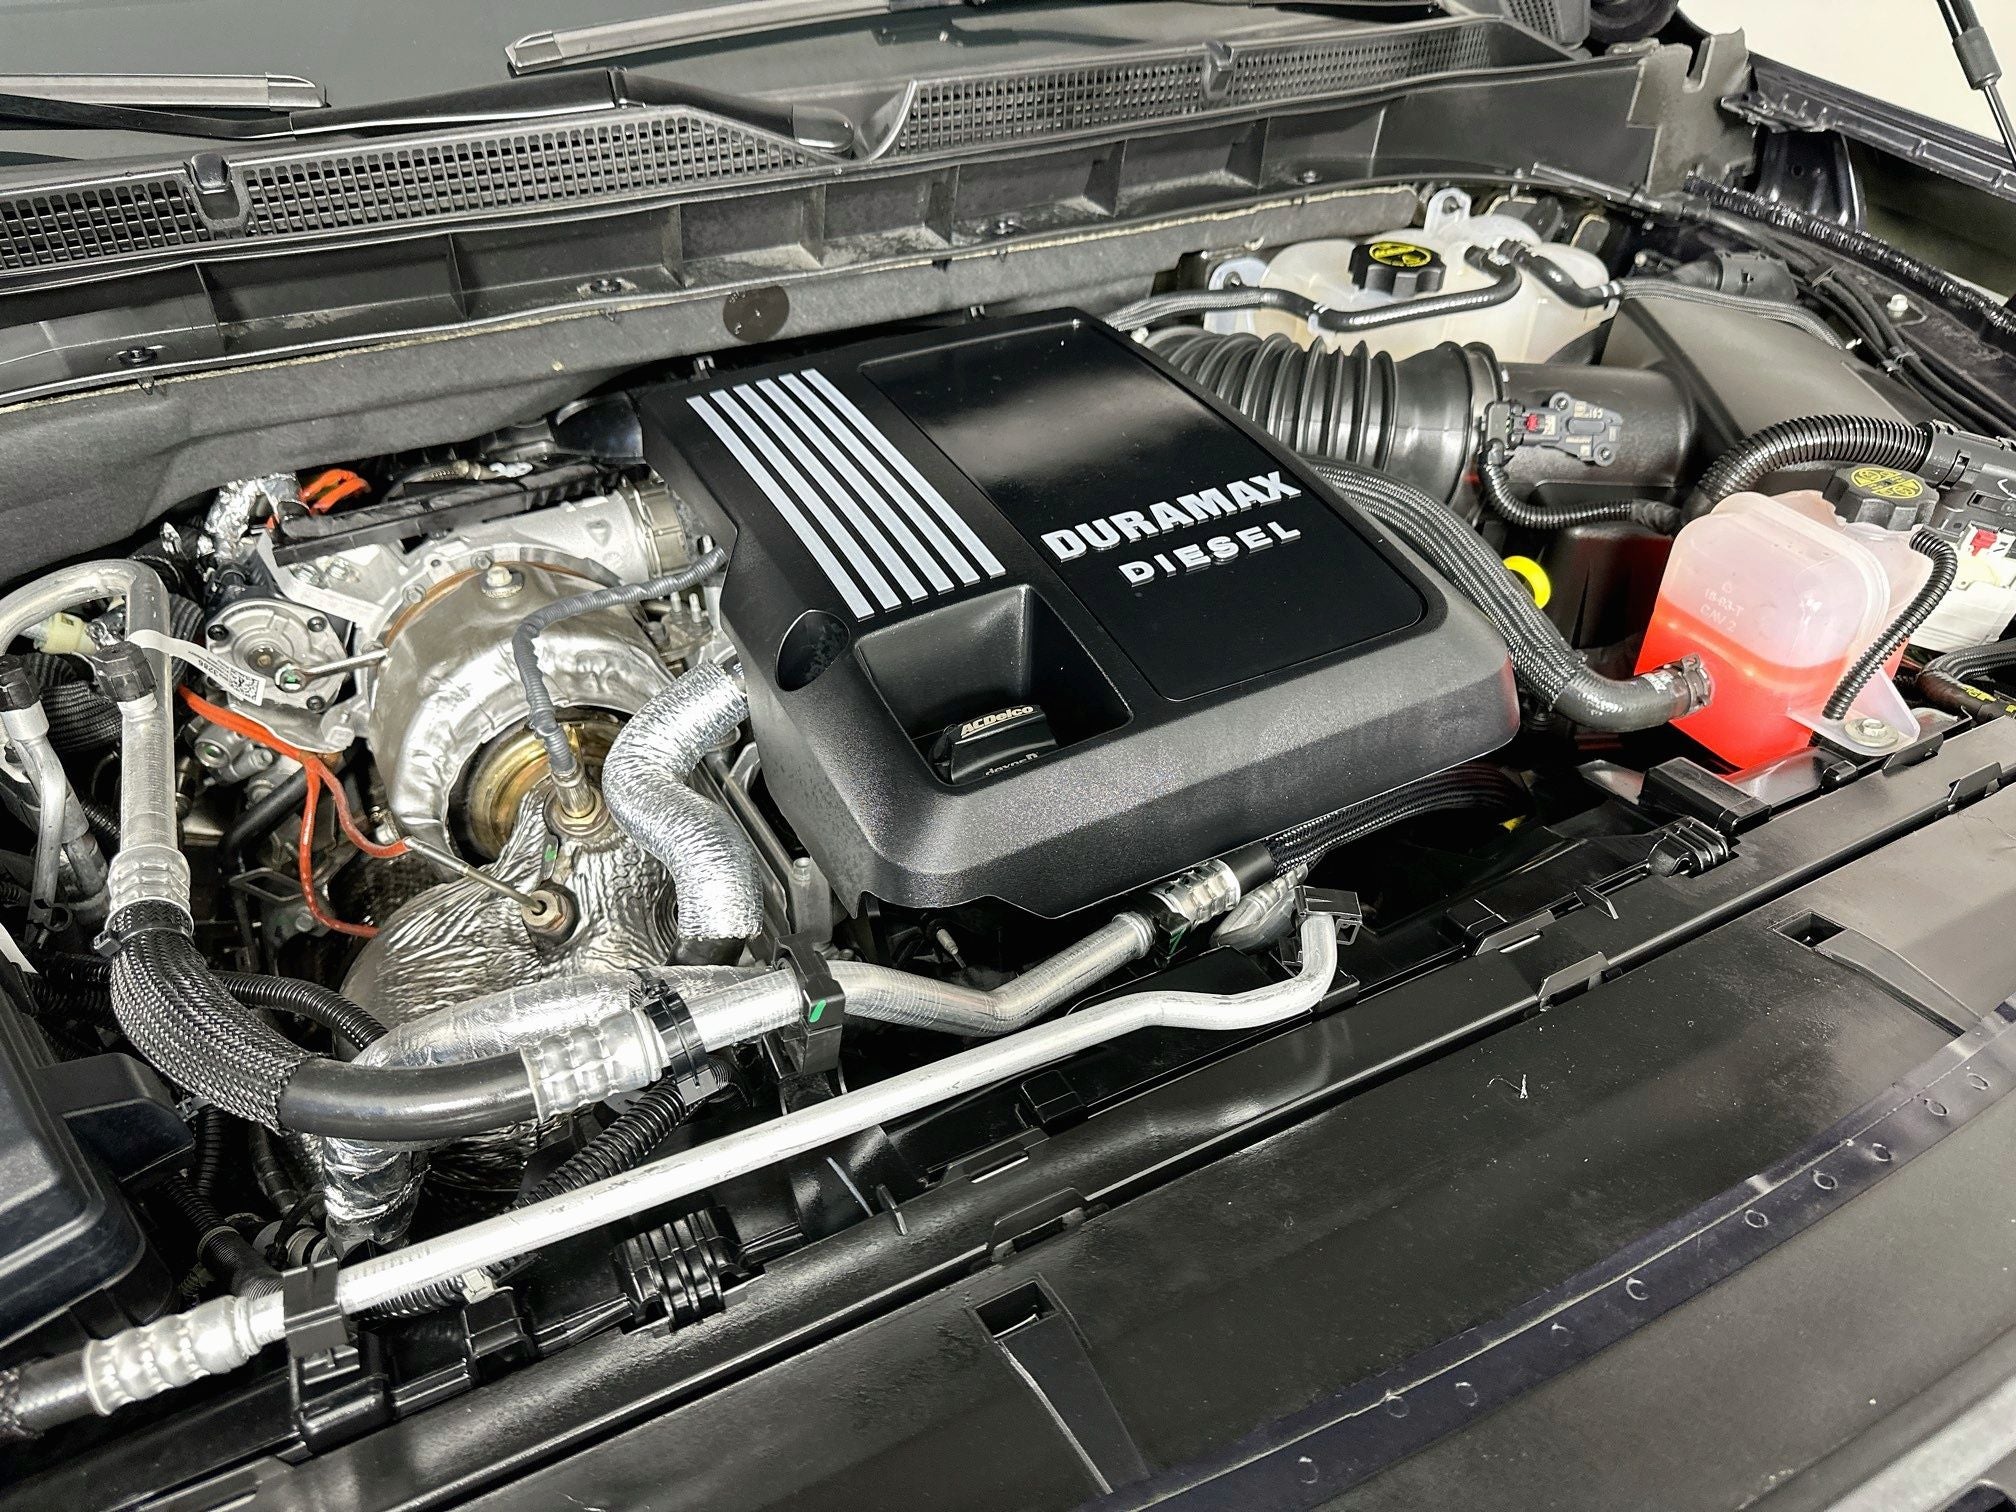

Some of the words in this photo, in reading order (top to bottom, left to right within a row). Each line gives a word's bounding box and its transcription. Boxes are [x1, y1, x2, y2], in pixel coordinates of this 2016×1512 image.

[1040, 471, 1303, 563] DURAMAX
[1118, 521, 1302, 587] DIESEL
[961, 706, 1034, 737] ACDelco
